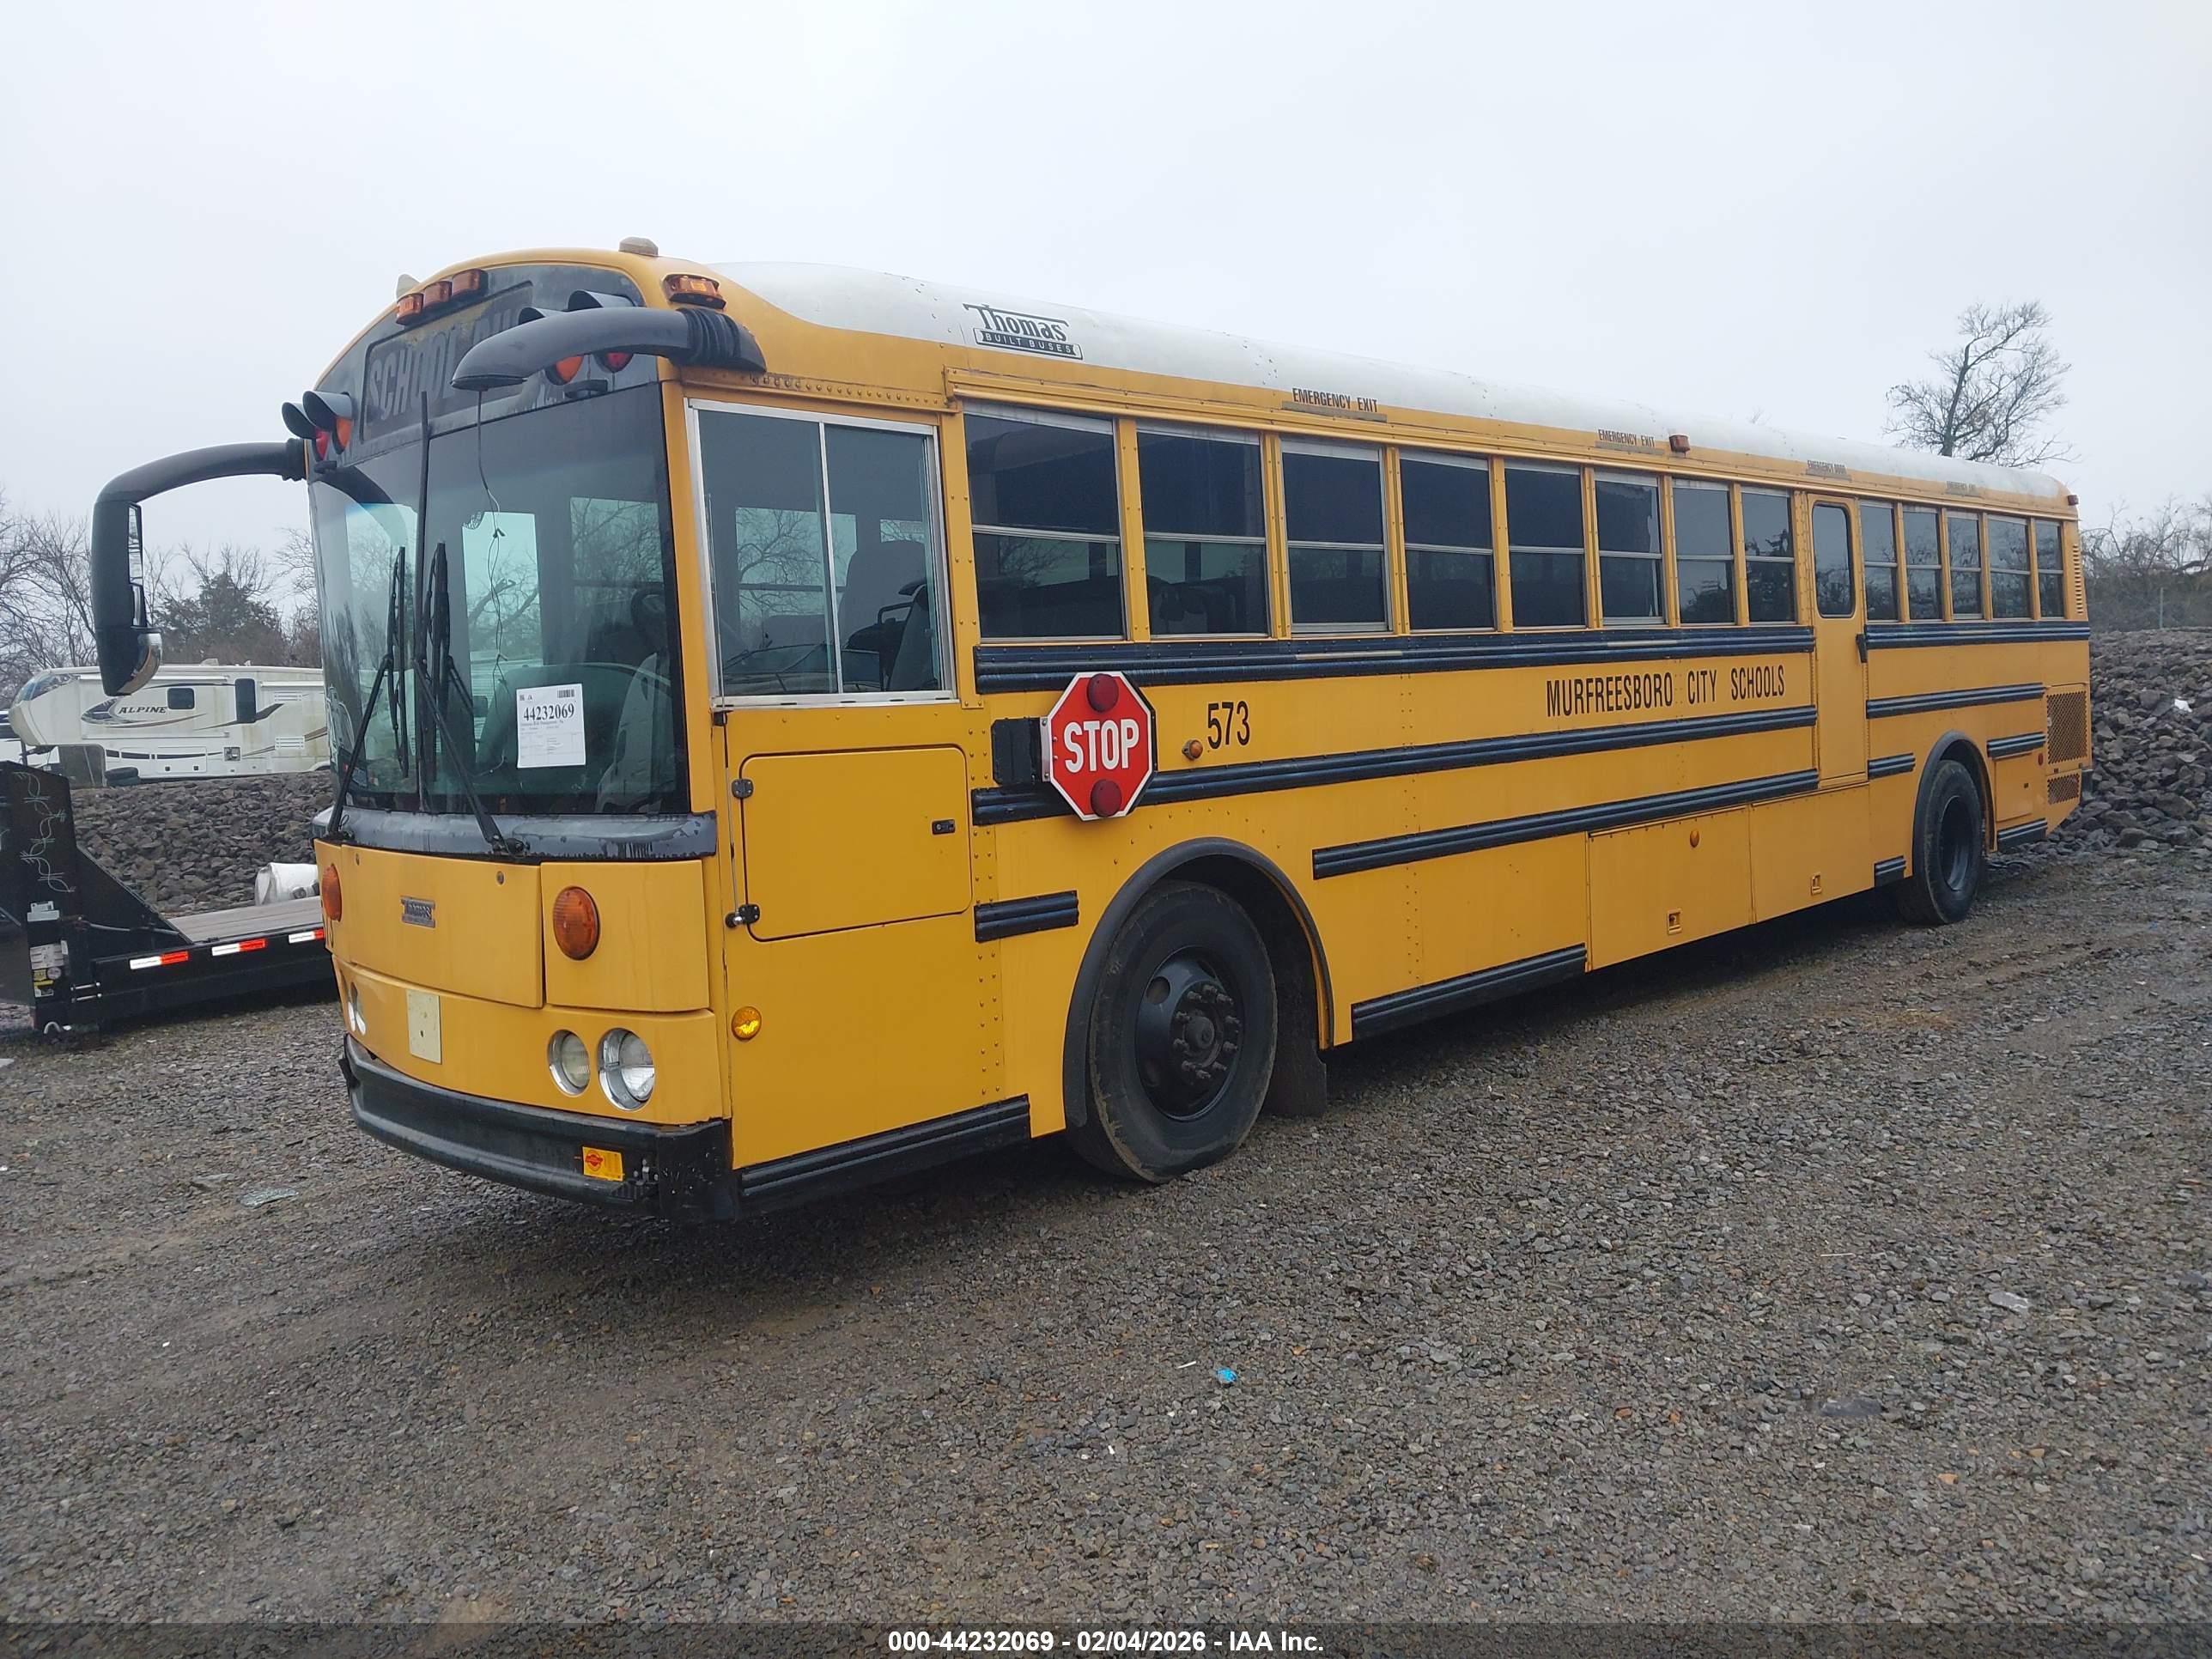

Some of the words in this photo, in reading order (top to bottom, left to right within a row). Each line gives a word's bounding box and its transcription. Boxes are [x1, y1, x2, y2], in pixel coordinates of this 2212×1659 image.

[963, 303, 1069, 342] Thomas
[985, 333, 1022, 347] BUILT
[1029, 340, 1072, 353] BUSES
[369, 327, 458, 419] SCHOOL
[1292, 387, 1351, 409] EMERGENCY
[1357, 397, 1378, 412] EXIT
[1598, 429, 1637, 446] EMERGENCY
[1641, 436, 1655, 447] EXIT
[1547, 672, 1674, 717] MURFREESBORO
[1687, 670, 1717, 704] CITY
[1730, 665, 1785, 701] SCHOOLS
[524, 703, 574, 721] 44232069
[1207, 701, 1250, 749] 573
[1064, 719, 1139, 774] STOP
